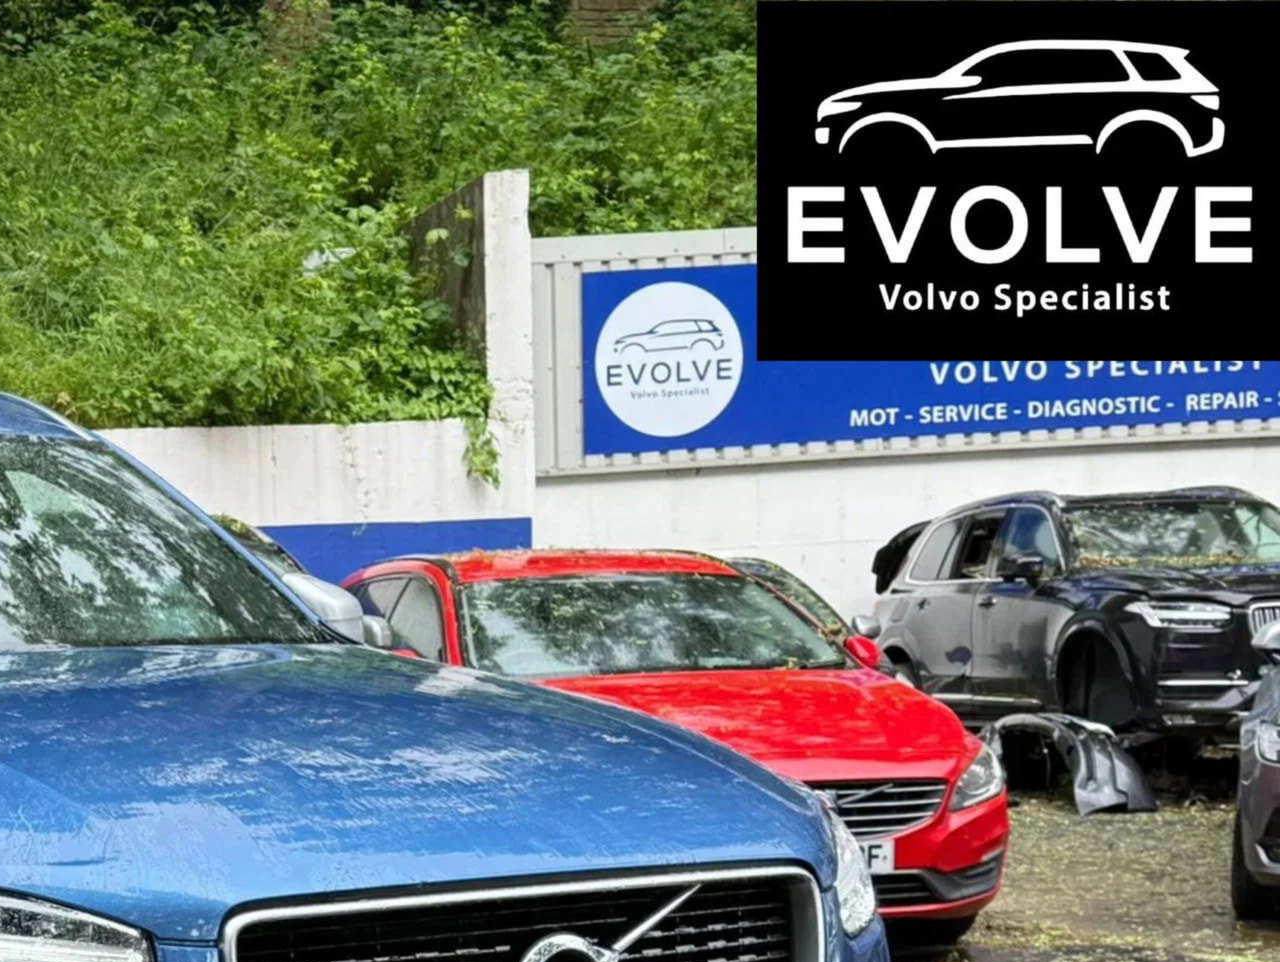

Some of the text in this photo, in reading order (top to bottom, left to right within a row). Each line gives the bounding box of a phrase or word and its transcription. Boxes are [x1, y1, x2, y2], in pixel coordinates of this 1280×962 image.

[606, 358, 733, 387] EVOLVE
[929, 361, 1048, 385] VOLVO
[630, 387, 710, 400] Volvo Specialist
[849, 407, 900, 427] MOT
[918, 402, 1008, 424] SERVICE
[1027, 395, 1161, 418] DIAGNOSTIC
[1185, 390, 1260, 412] REPAIR
